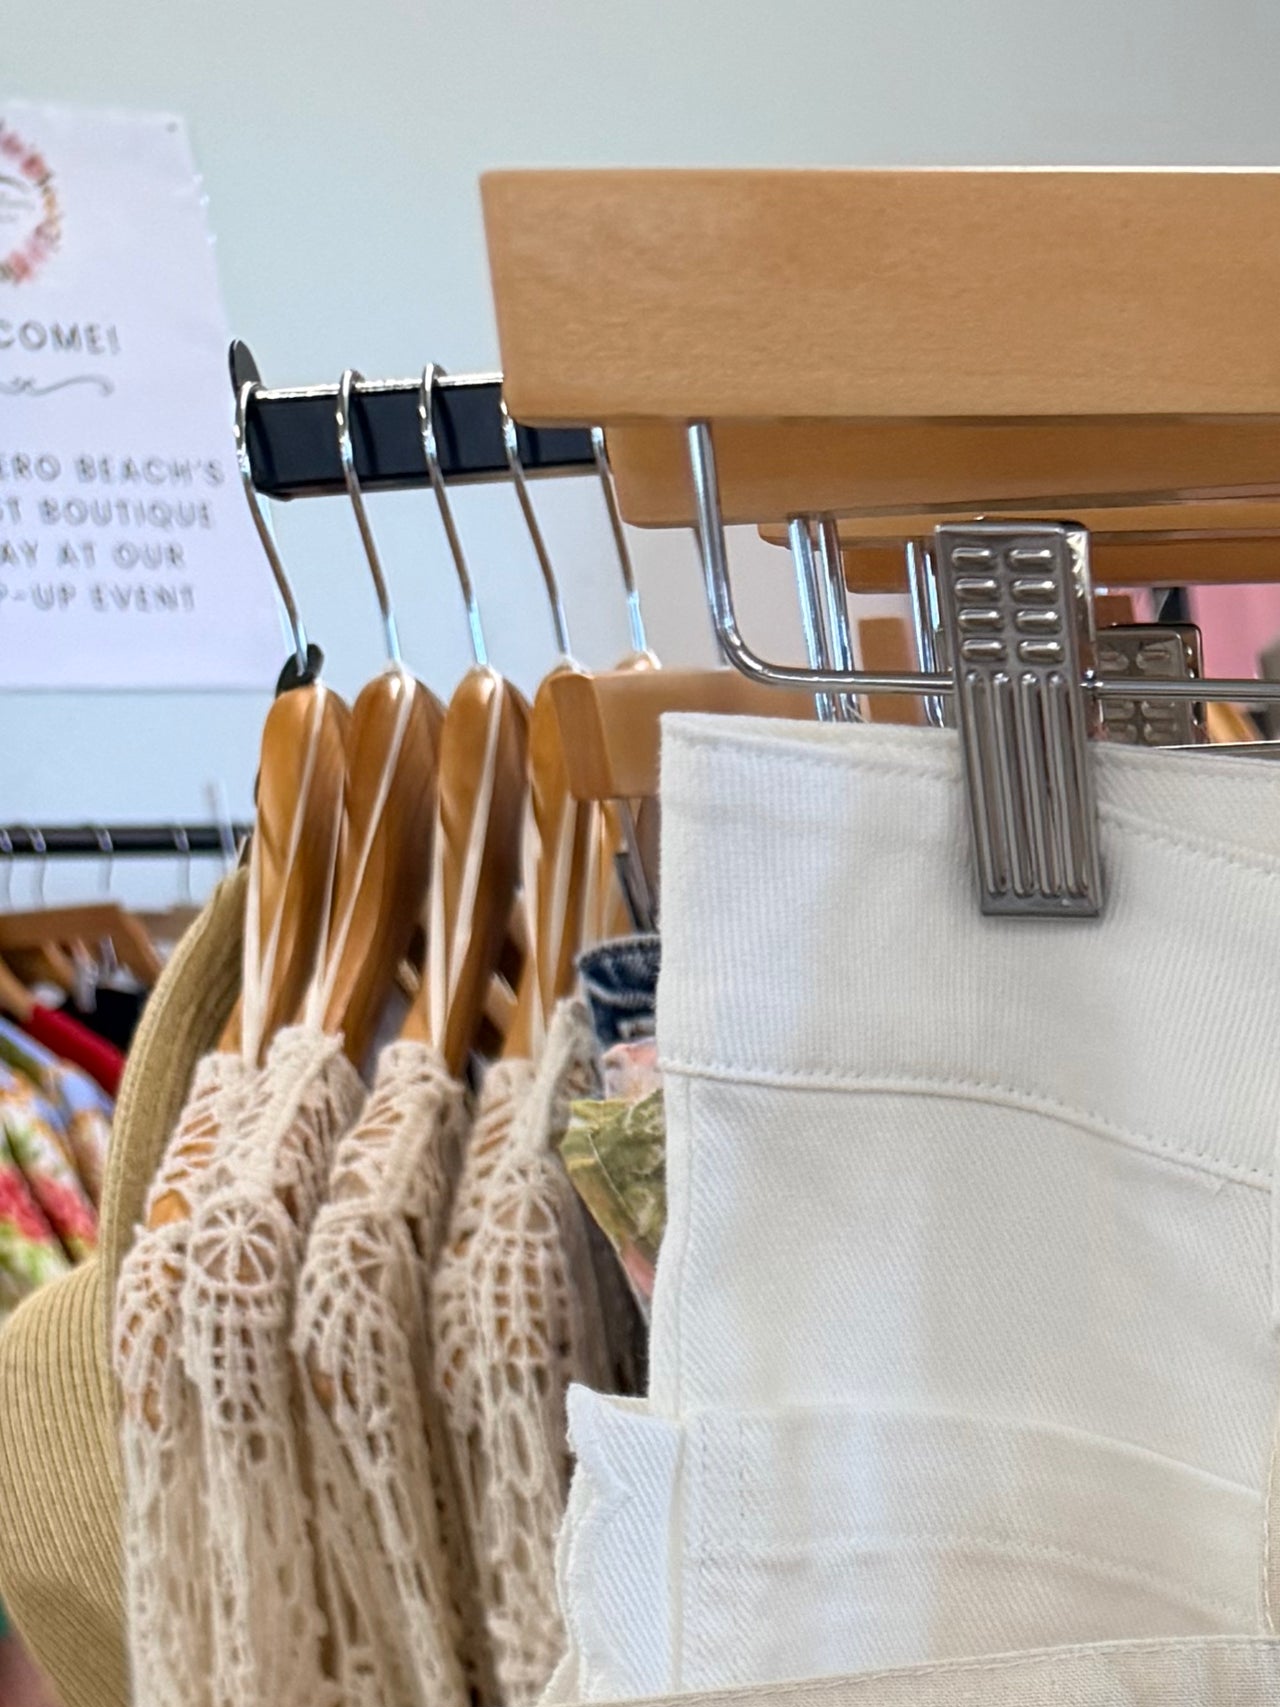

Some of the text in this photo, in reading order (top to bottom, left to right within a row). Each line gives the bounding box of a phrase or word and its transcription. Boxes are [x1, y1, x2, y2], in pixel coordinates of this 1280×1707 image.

[76, 453, 225, 486] BEACH'S
[39, 496, 213, 532] BOUTIQUE
[57, 541, 96, 569] AT
[113, 541, 186, 570] OUR
[91, 582, 195, 612] EVENT
